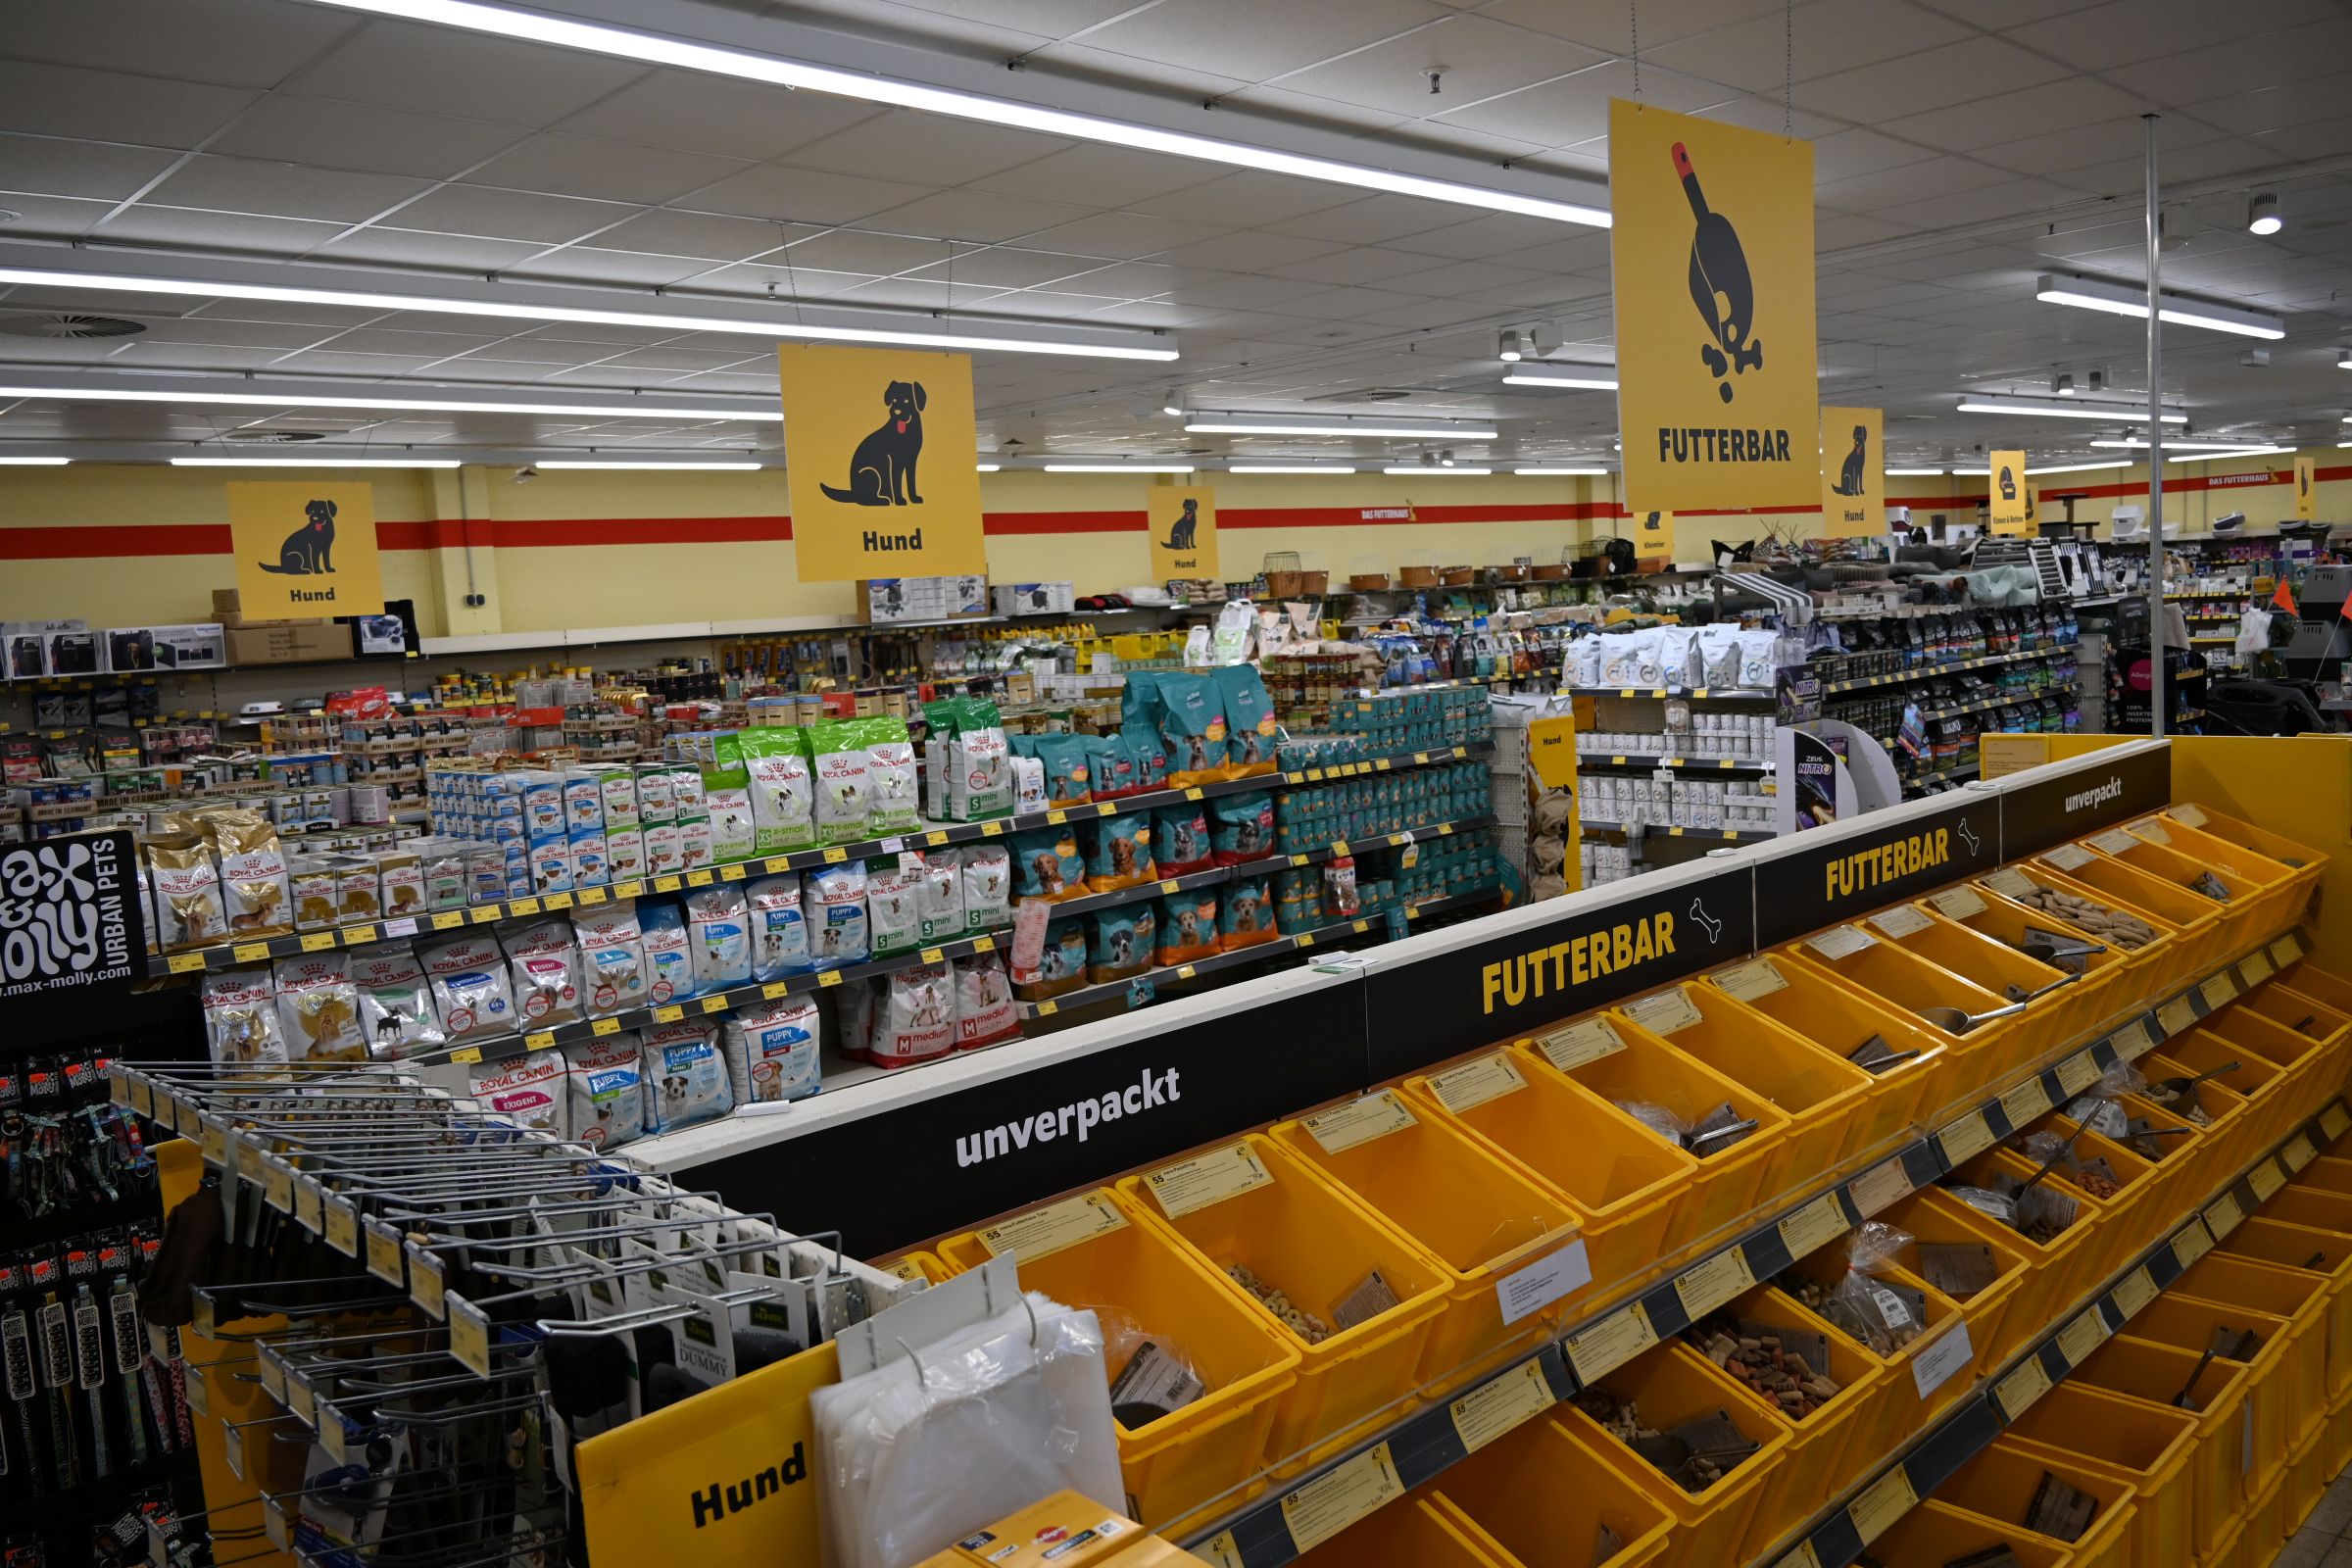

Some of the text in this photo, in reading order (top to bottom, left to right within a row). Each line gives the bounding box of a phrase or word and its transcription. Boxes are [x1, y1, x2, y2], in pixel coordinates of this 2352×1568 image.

[1658, 427, 1791, 463] FUTTERBAR
[2208, 473, 2270, 486] DAS FUTTERHAUS
[1361, 508, 1409, 519] DAS FUTTERHAUS
[1843, 510, 1865, 522] Hund
[862, 527, 923, 552] Hund
[1174, 558, 1197, 569] Hund
[290, 587, 336, 603] Hund
[1543, 735, 1562, 746] Hund
[842, 766, 865, 777] CANIN
[1797, 763, 1833, 775] NITRO
[97, 792, 171, 807] MADE IN GERMANY
[2064, 774, 2125, 816] unverpackt
[773, 824, 806, 834] x-small
[91, 838, 121, 891] PETS
[1824, 825, 1950, 900] FUTTERBAR
[0, 843, 96, 902] ax
[229, 863, 283, 879] ROYAL CANIN
[0, 898, 34, 928] &
[831, 906, 853, 916] PUPPY
[982, 906, 1000, 917] mini
[934, 915, 952, 926] mini
[99, 894, 131, 966] URBAN
[887, 930, 905, 941] mini
[0, 899, 99, 981] olly
[433, 951, 493, 971] ROYAL CANIN
[1482, 909, 1677, 1016] FUTTERBAR
[0, 965, 131, 999] .max-molly.com
[386, 968, 415, 981] CANIN
[285, 977, 313, 989] ROYAL
[202, 988, 266, 1005] ROYAL CANIN
[976, 1005, 1010, 1023] medium
[766, 1028, 793, 1043] PUPPY
[912, 1027, 949, 1042] medium
[603, 1048, 638, 1063] CANIN
[479, 1062, 555, 1092] ROYAL CANIN
[592, 1072, 621, 1087] PUPPY
[503, 1094, 538, 1110] EXIGENT
[956, 1065, 1182, 1168] unverpackt
[1152, 1174, 1164, 1185] 55
[986, 1230, 1002, 1241] 55
[679, 1348, 728, 1377] DUMMY
[1455, 1404, 1466, 1415] 55
[691, 1441, 807, 1529] Hund
[1287, 1494, 1298, 1506] 55
